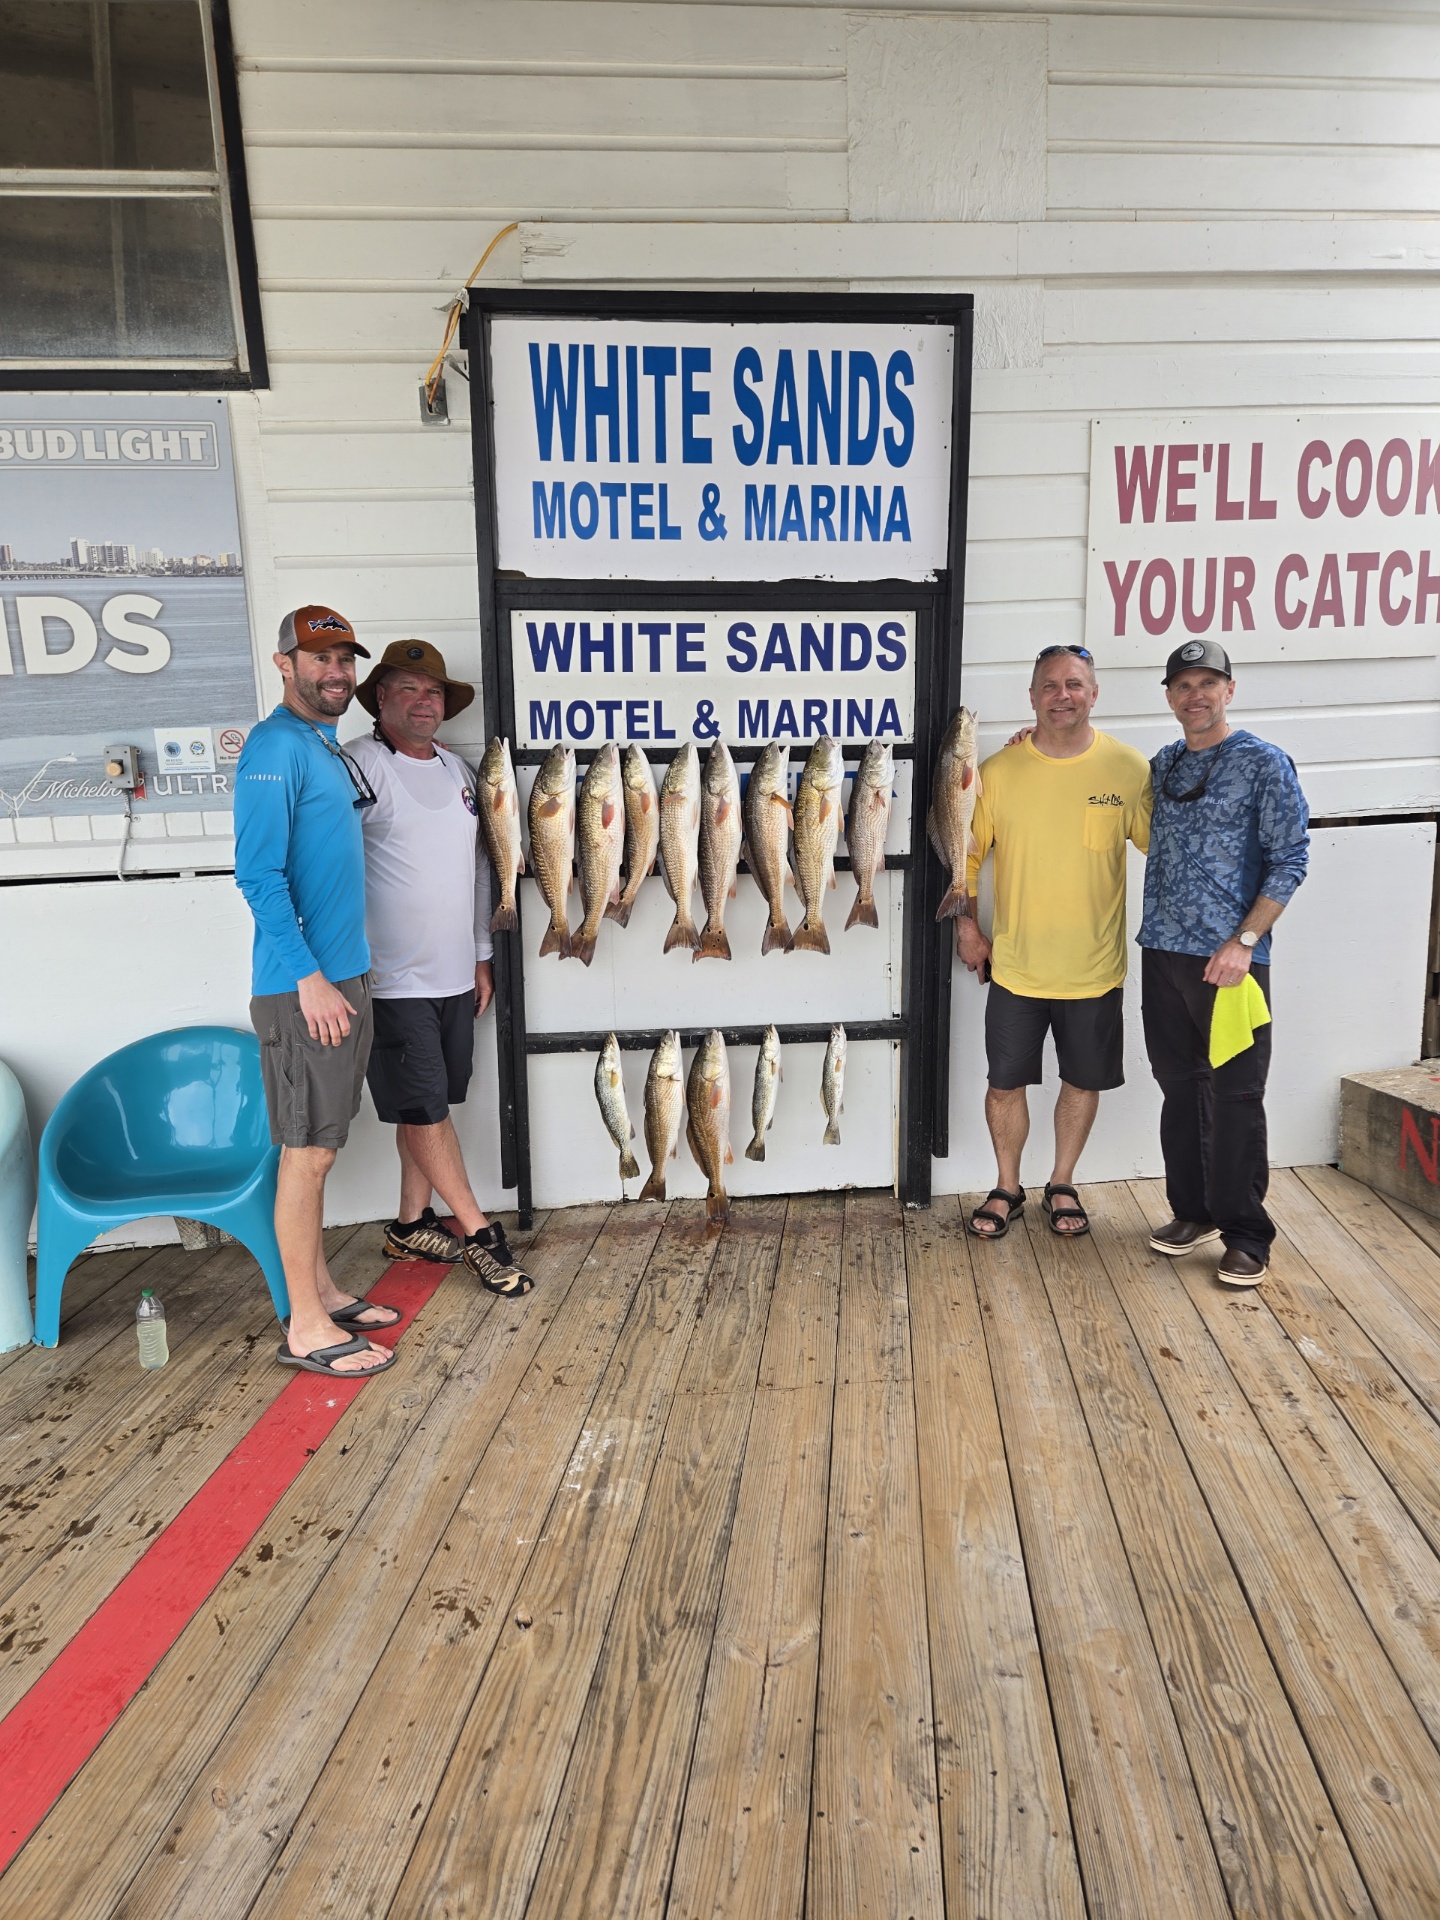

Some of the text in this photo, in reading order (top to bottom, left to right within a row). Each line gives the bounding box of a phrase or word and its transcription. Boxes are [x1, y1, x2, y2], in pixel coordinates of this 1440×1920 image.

[528, 342, 915, 468] WHITE SANDS
[81, 429, 208, 461] LIGHT
[532, 480, 912, 543] MOTEL & MARINA
[1114, 438, 1440, 524] WE'LL COOK
[1103, 550, 1440, 637] YOUR CATCH
[0, 593, 171, 675] DS
[526, 621, 907, 673] WHITE SANDS
[528, 698, 903, 740] MOTEL & MARINA
[153, 774, 236, 796] ULTR
